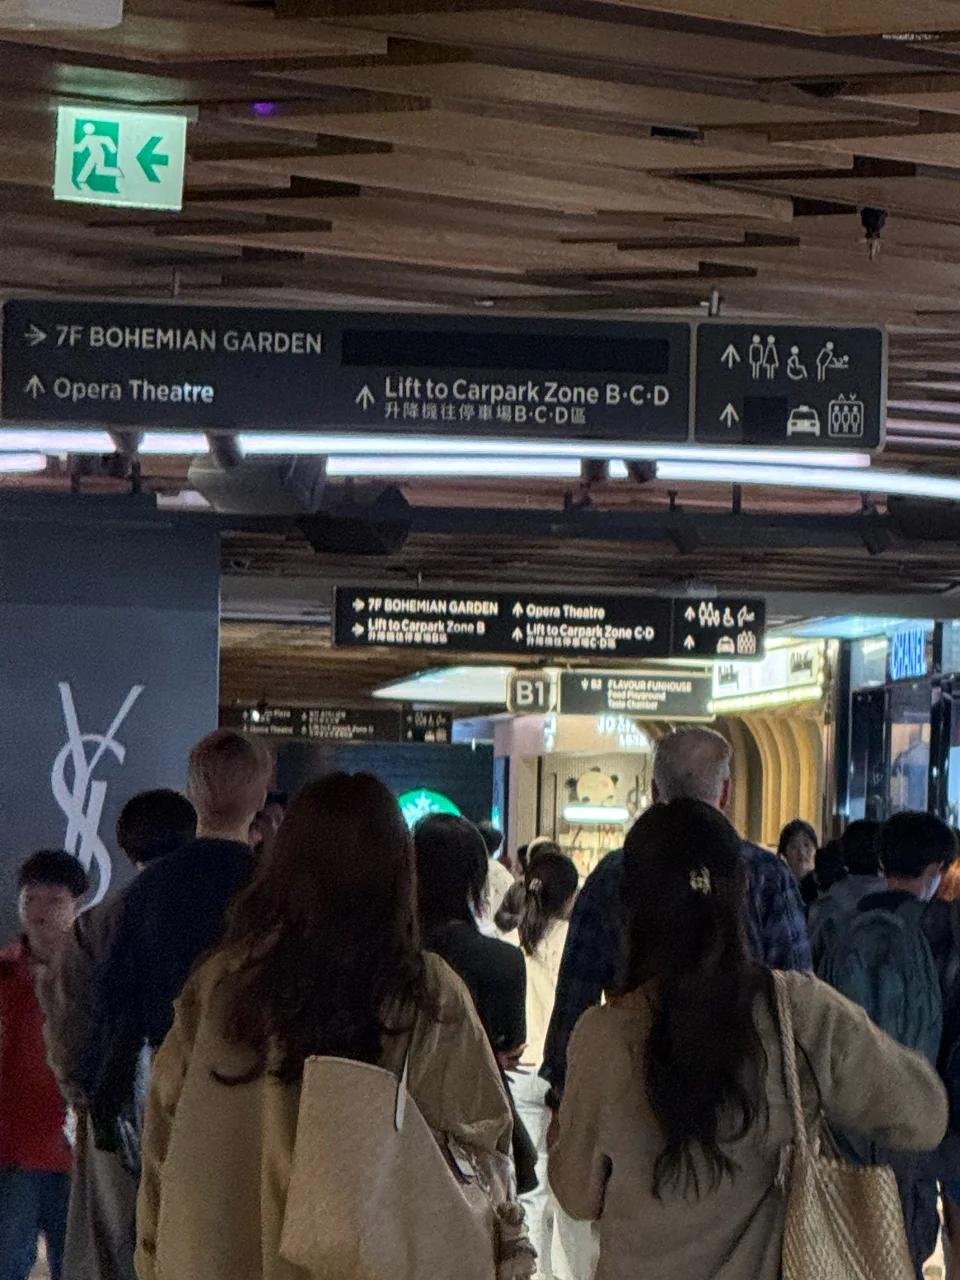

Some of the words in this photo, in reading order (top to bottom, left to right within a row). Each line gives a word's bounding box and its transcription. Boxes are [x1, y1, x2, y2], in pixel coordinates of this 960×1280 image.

[55, 325, 84, 347] 7F
[89, 327, 216, 352] BOHEMIAN
[223, 331, 322, 355] GARDEN
[53, 377, 121, 402] Opera
[129, 379, 215, 404] Theatre
[385, 377, 421, 398] Lift
[427, 380, 448, 399] to
[452, 379, 540, 404] Carpark
[543, 381, 599, 404] Zone
[384, 598, 447, 615] BOHEMIAN
[449, 600, 499, 616] GARDEN
[526, 603, 561, 618] Opera
[562, 604, 606, 620] Theatre
[368, 618, 387, 632] Lift
[388, 619, 400, 632] to
[401, 619, 445, 634] Carpark
[447, 620, 475, 634] Zone
[526, 622, 546, 636] Lift
[547, 624, 559, 636] to
[560, 624, 603, 638] Carpark
[604, 625, 633, 639] Zone
[516, 680, 544, 706] B1
[608, 678, 648, 691] FLAVOUR
